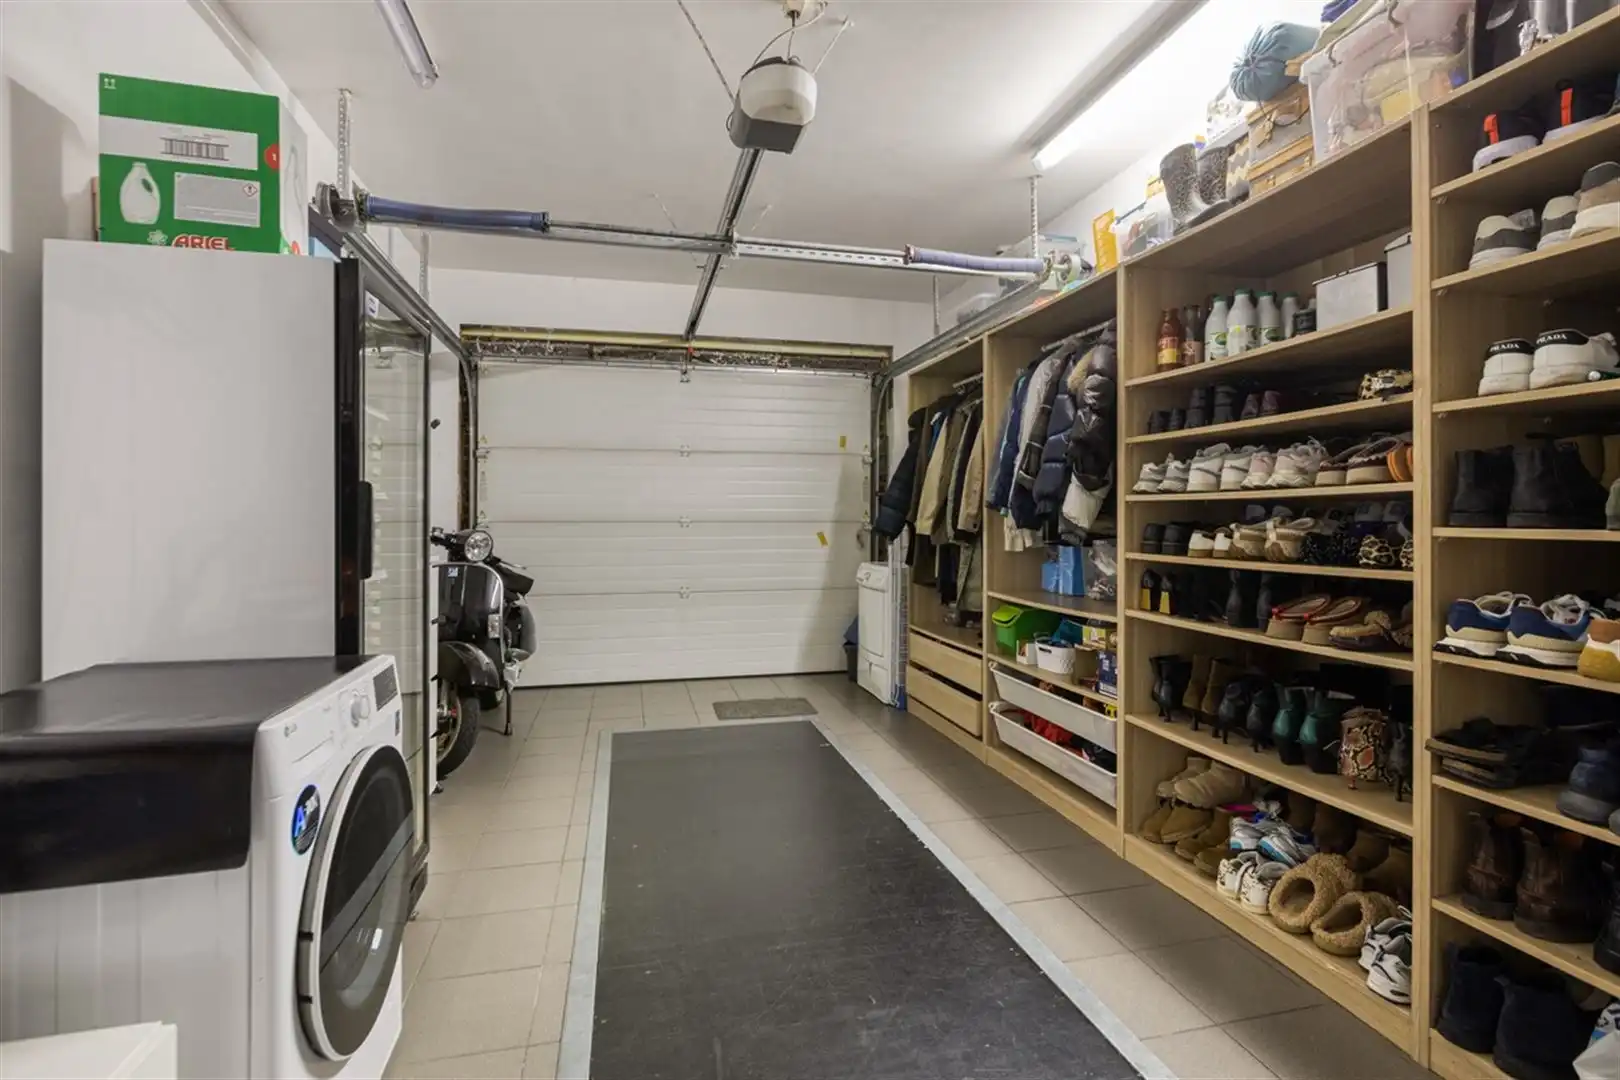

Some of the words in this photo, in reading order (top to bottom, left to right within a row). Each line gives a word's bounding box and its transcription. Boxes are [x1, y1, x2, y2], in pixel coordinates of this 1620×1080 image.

[172, 235, 235, 251] ARIEL
[1536, 333, 1567, 344] PRADA
[1490, 343, 1520, 352] PRADA
